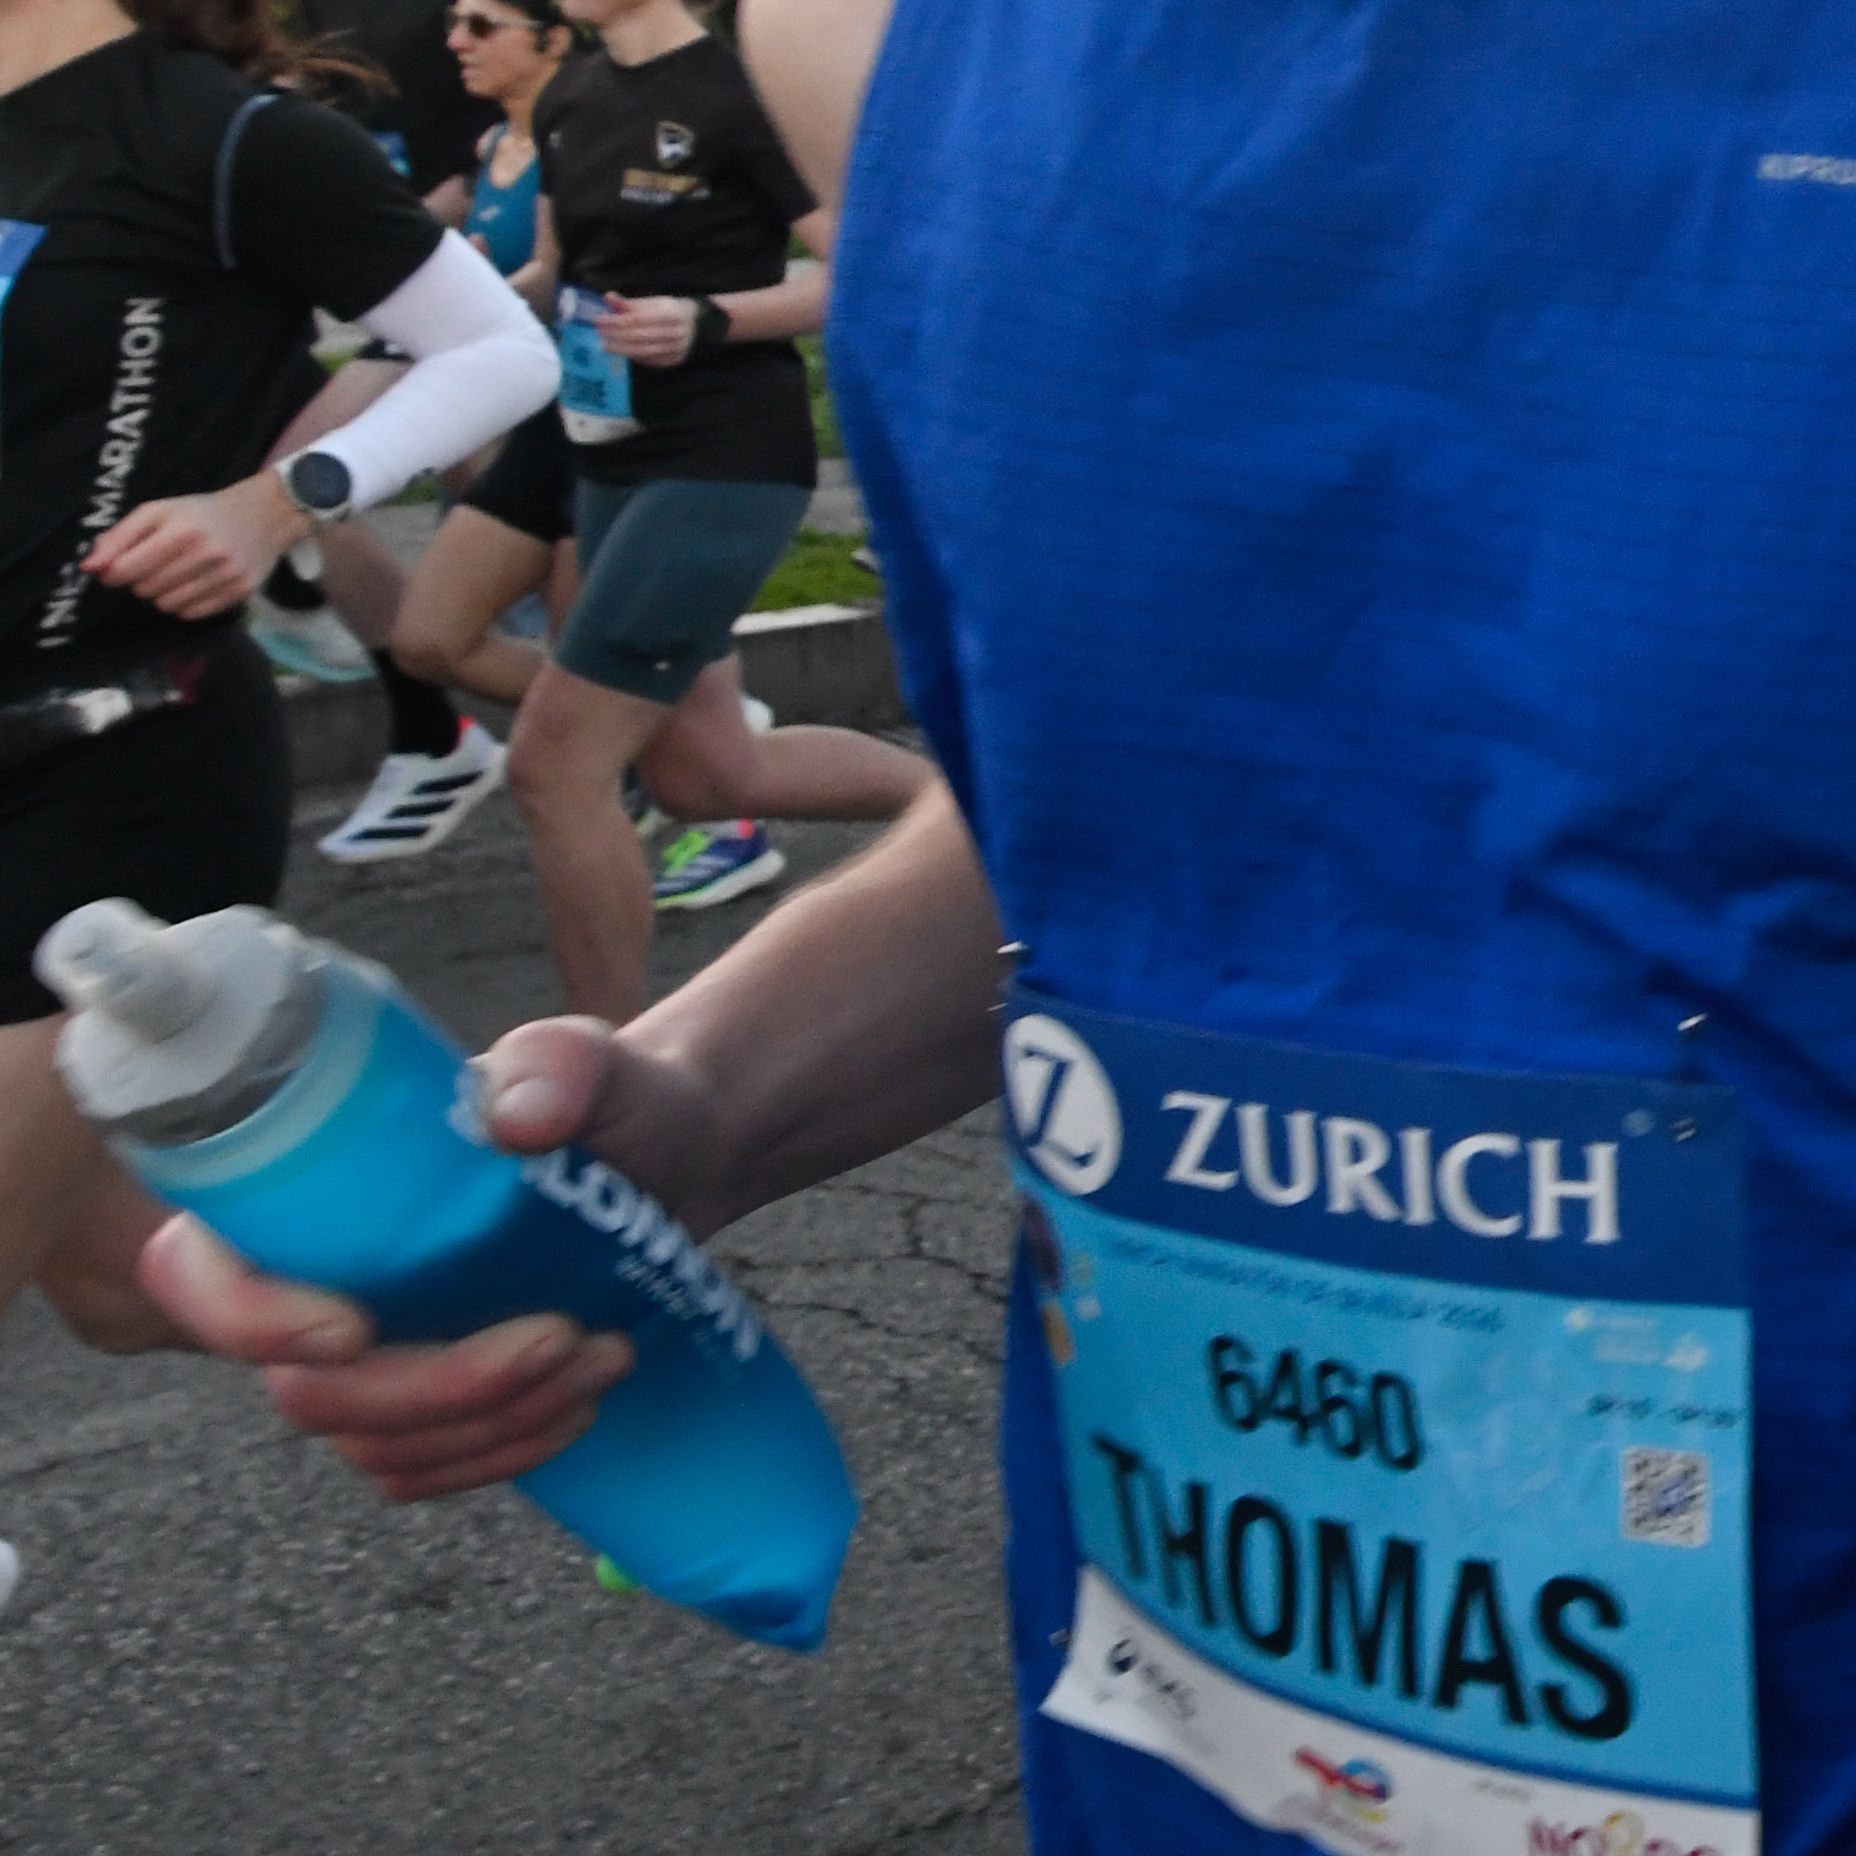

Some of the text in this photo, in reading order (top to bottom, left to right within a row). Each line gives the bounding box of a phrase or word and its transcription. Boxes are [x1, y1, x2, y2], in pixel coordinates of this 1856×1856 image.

[82, 297, 165, 526] MARATHON
[1161, 1090, 1621, 1244] ZURICH
[1206, 1334, 1427, 1472] 6460
[1090, 1432, 1634, 1743] THOMAS
